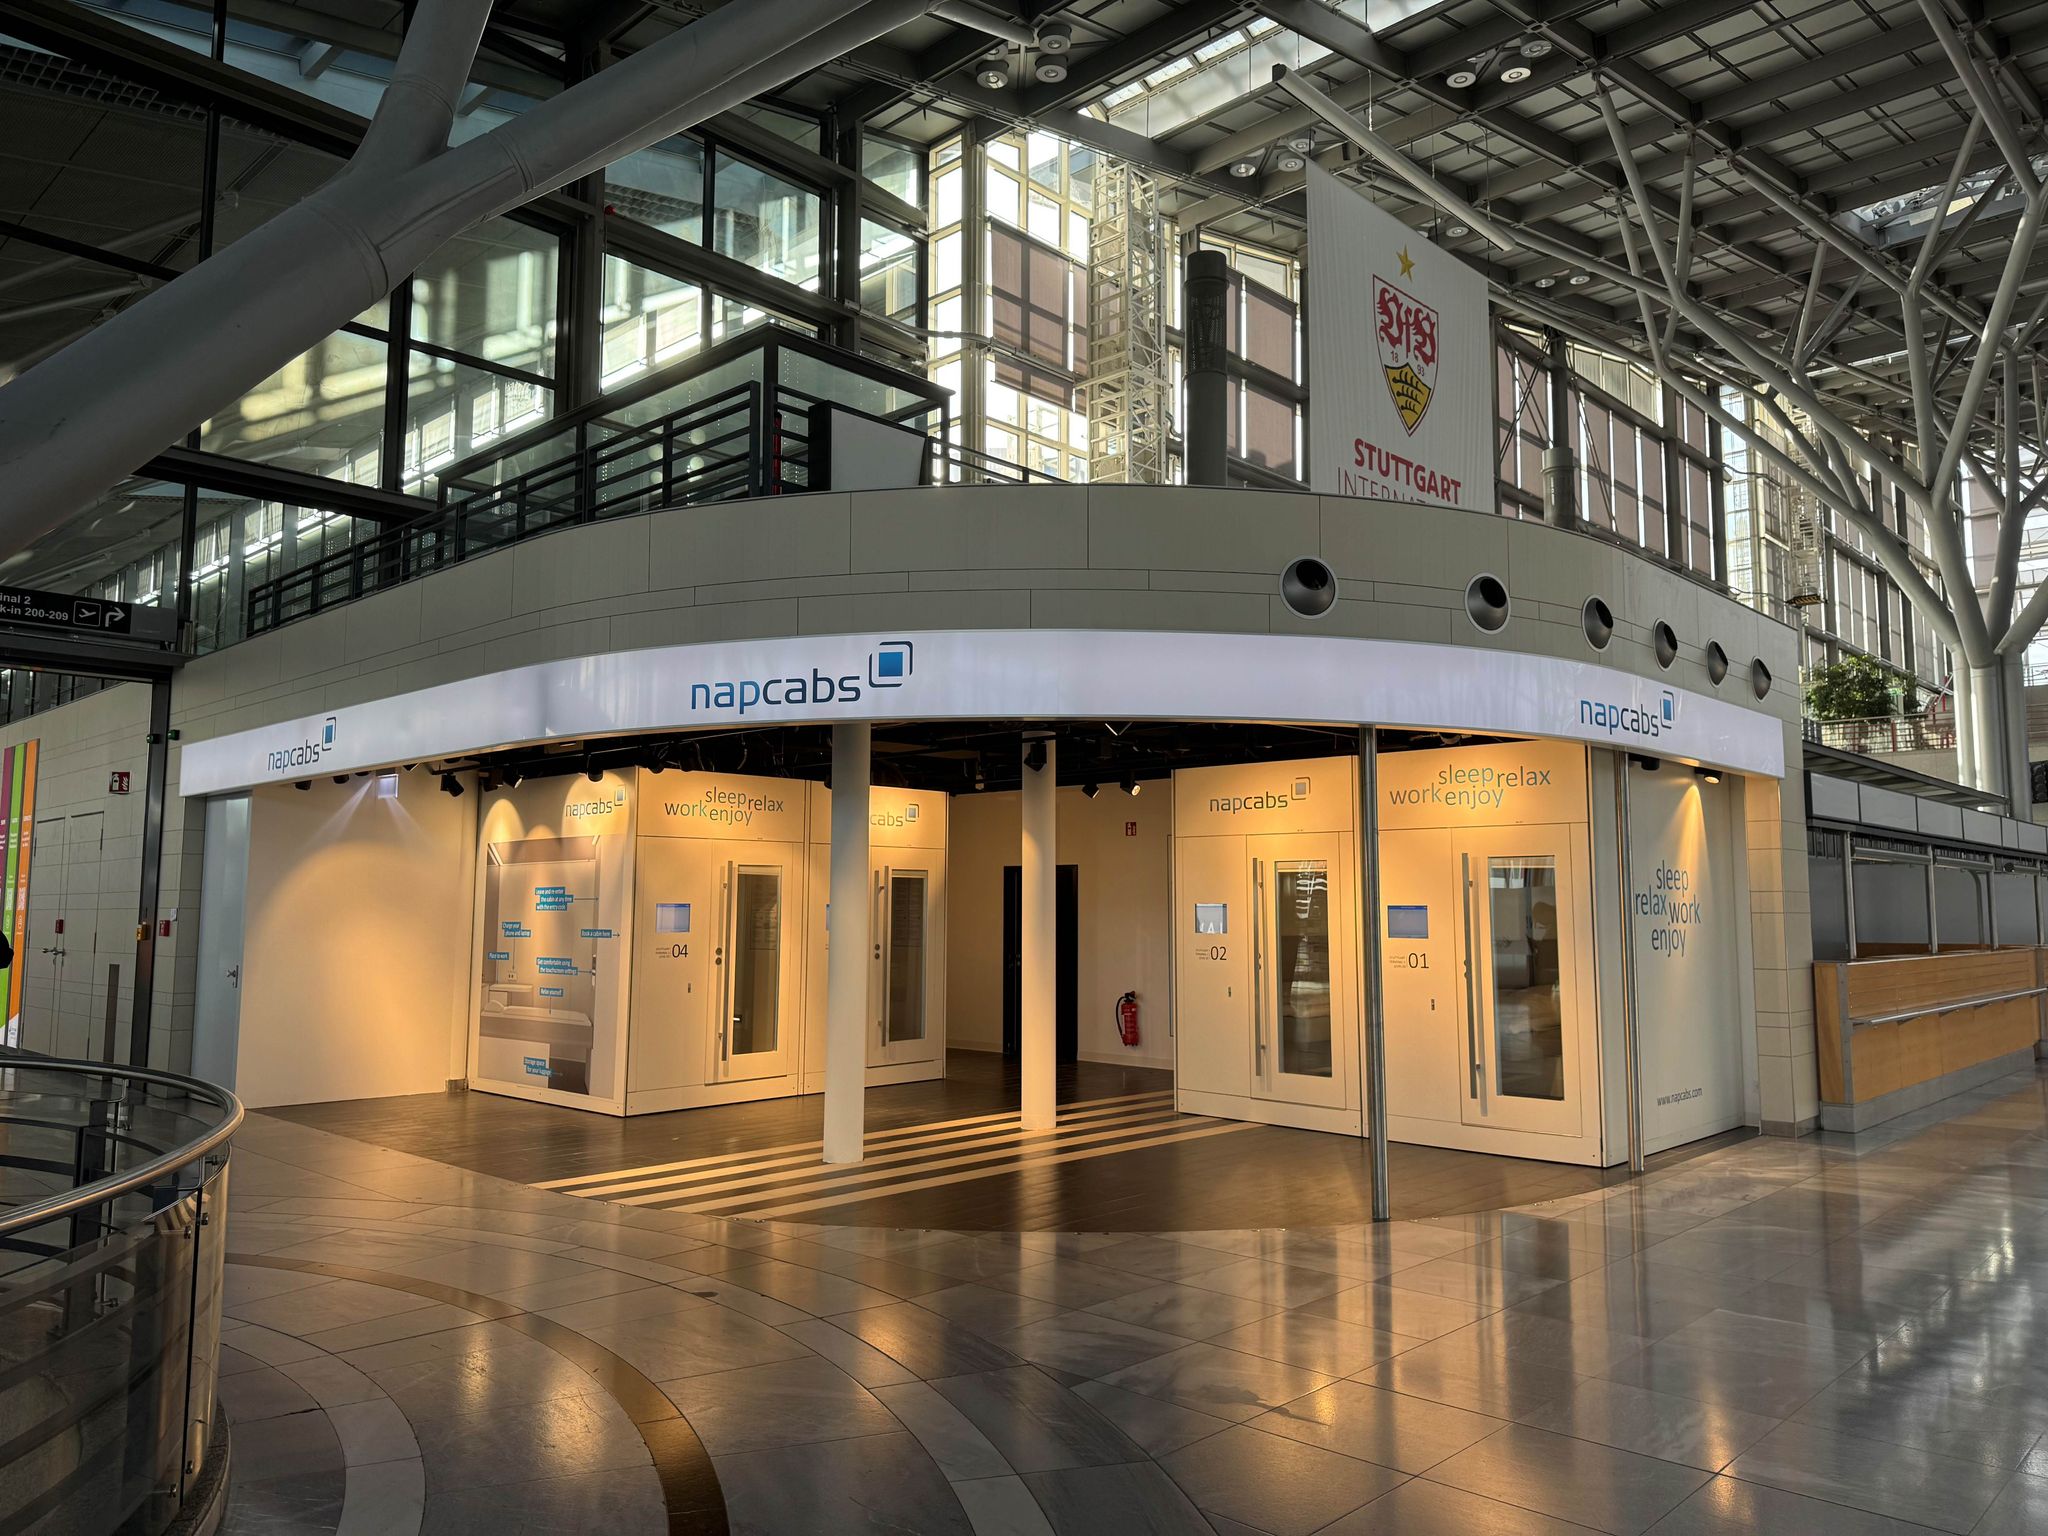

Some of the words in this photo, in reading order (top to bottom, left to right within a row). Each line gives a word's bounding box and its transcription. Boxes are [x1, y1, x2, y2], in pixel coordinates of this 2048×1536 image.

[1354, 438, 1461, 505] STUTTGART
[24, 596, 31, 604] 2
[25, 607, 69, 620] 200-209
[691, 668, 861, 715] napcabs
[1580, 704, 1659, 737] napcabs
[267, 739, 320, 774] napcabs
[1438, 764, 1494, 787] sleep
[1497, 766, 1551, 788] relax
[565, 797, 613, 820] napcabs
[705, 786, 747, 808] sleep
[748, 795, 784, 812] relax
[1210, 791, 1288, 814] napcabs
[1389, 783, 1442, 805] work
[1445, 785, 1504, 809] enjoy
[664, 800, 708, 817] work
[709, 806, 753, 826] enjoy
[1656, 859, 1689, 898] sleep
[1635, 884, 1668, 916] relax
[1669, 894, 1702, 924] work
[672, 944, 688, 958] 04
[1651, 921, 1687, 958] enjoy
[1210, 946, 1227, 960] 02
[1408, 953, 1429, 969] 01
[1656, 1086, 1703, 1107] www.napcabs.com
